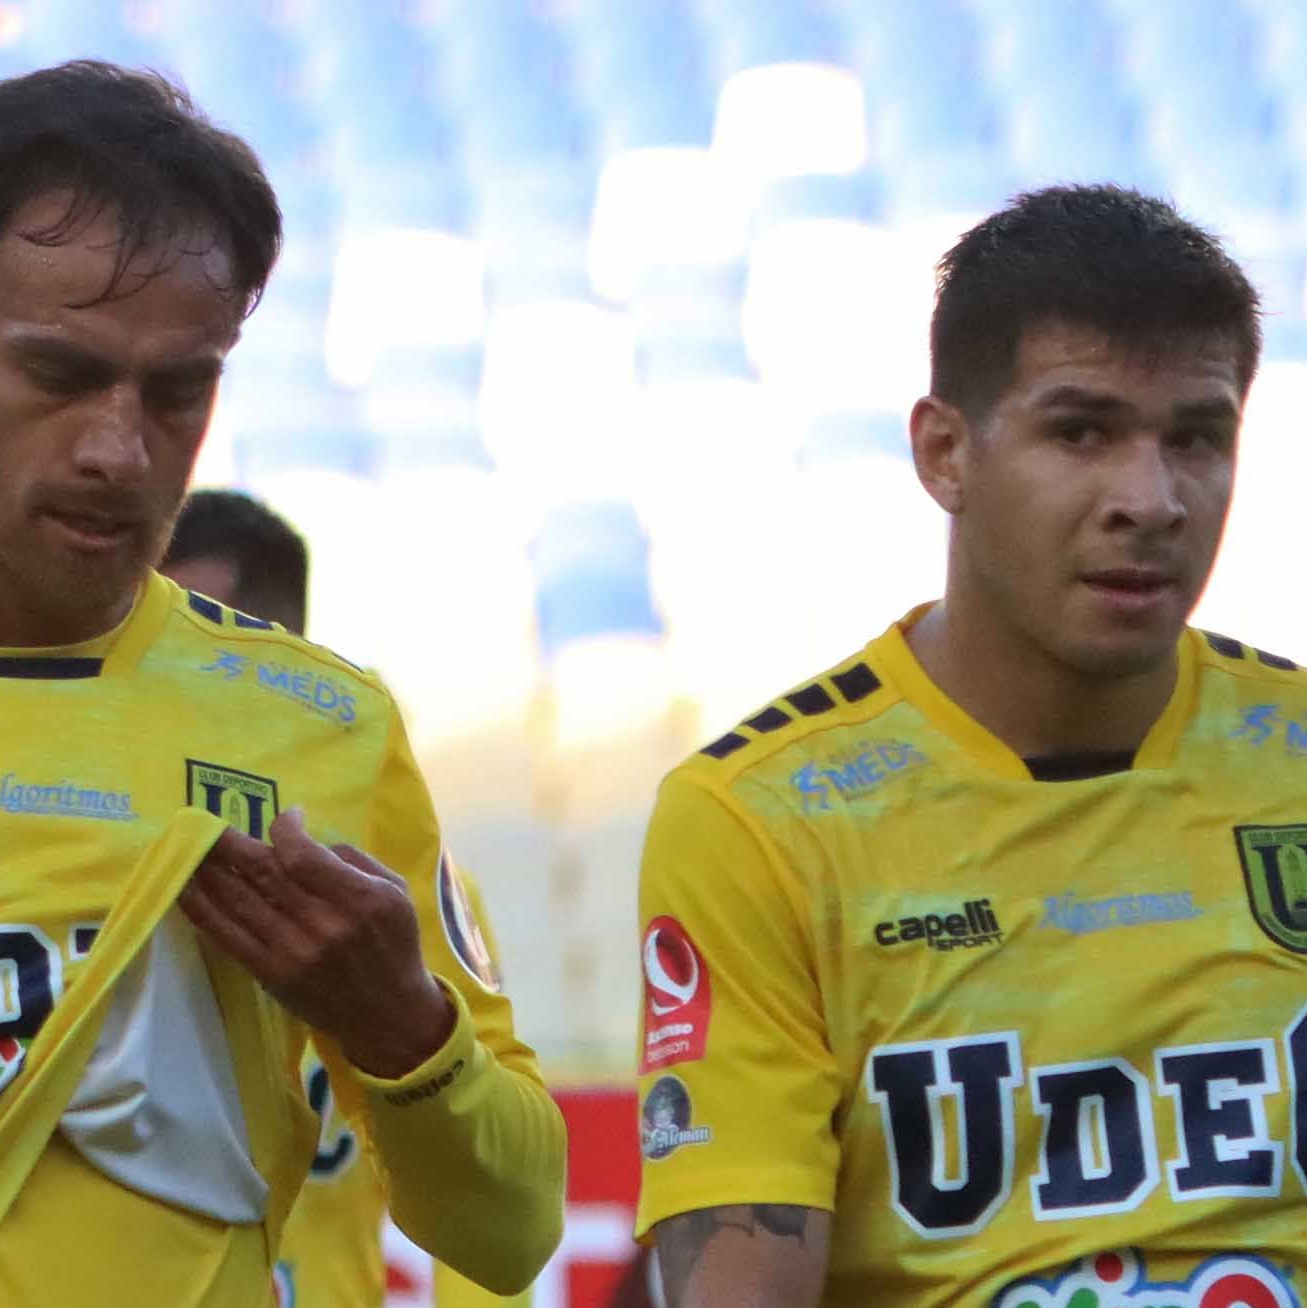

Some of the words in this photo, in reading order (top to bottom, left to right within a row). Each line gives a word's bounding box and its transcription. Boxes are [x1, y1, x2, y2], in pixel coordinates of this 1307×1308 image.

[257, 665, 356, 722] MEDS
[874, 898, 1001, 948] capelli
[935, 931, 1005, 952] SPORT
